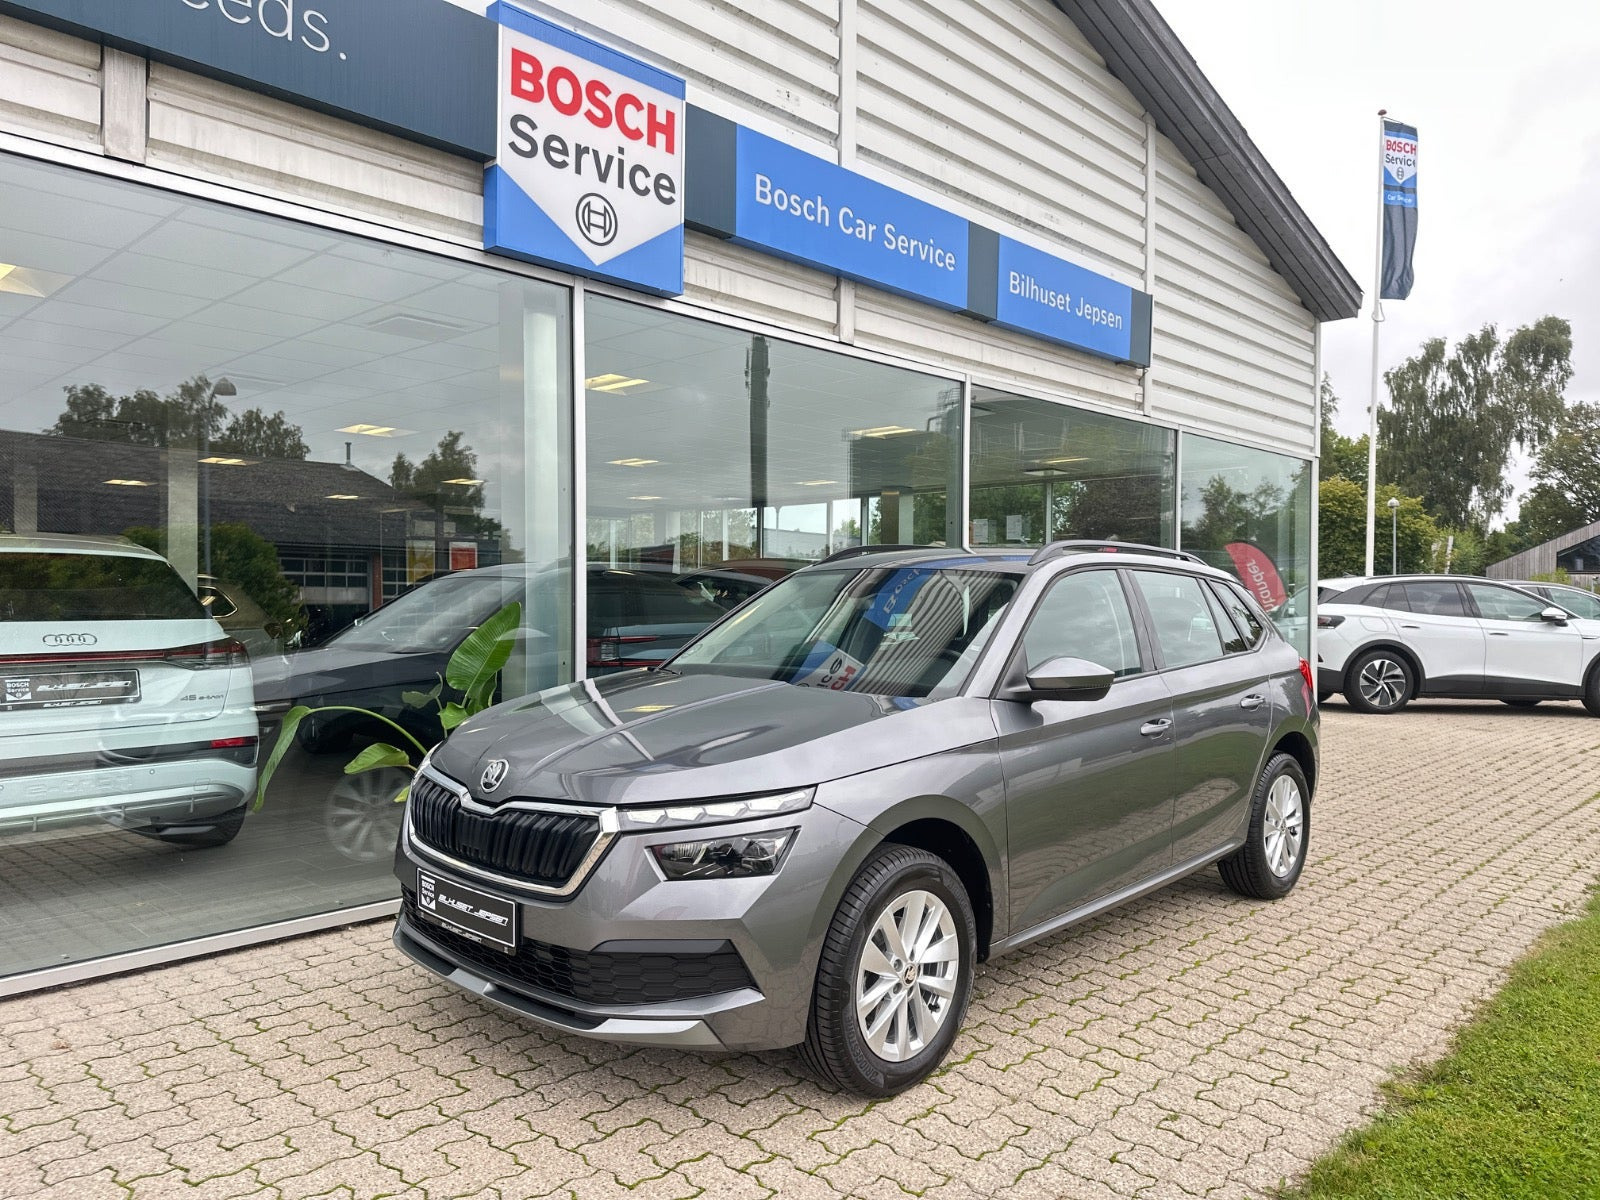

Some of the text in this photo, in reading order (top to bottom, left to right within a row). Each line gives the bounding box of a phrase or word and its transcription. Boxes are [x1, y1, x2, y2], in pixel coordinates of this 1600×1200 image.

[181, 0, 347, 61] eds.
[510, 47, 676, 156] BOSCH
[508, 113, 676, 206] Service
[1386, 139, 1417, 155] BOSCH
[755, 173, 956, 271] Bosch Car Service
[1009, 271, 1123, 330] Bilhuset Jepsen
